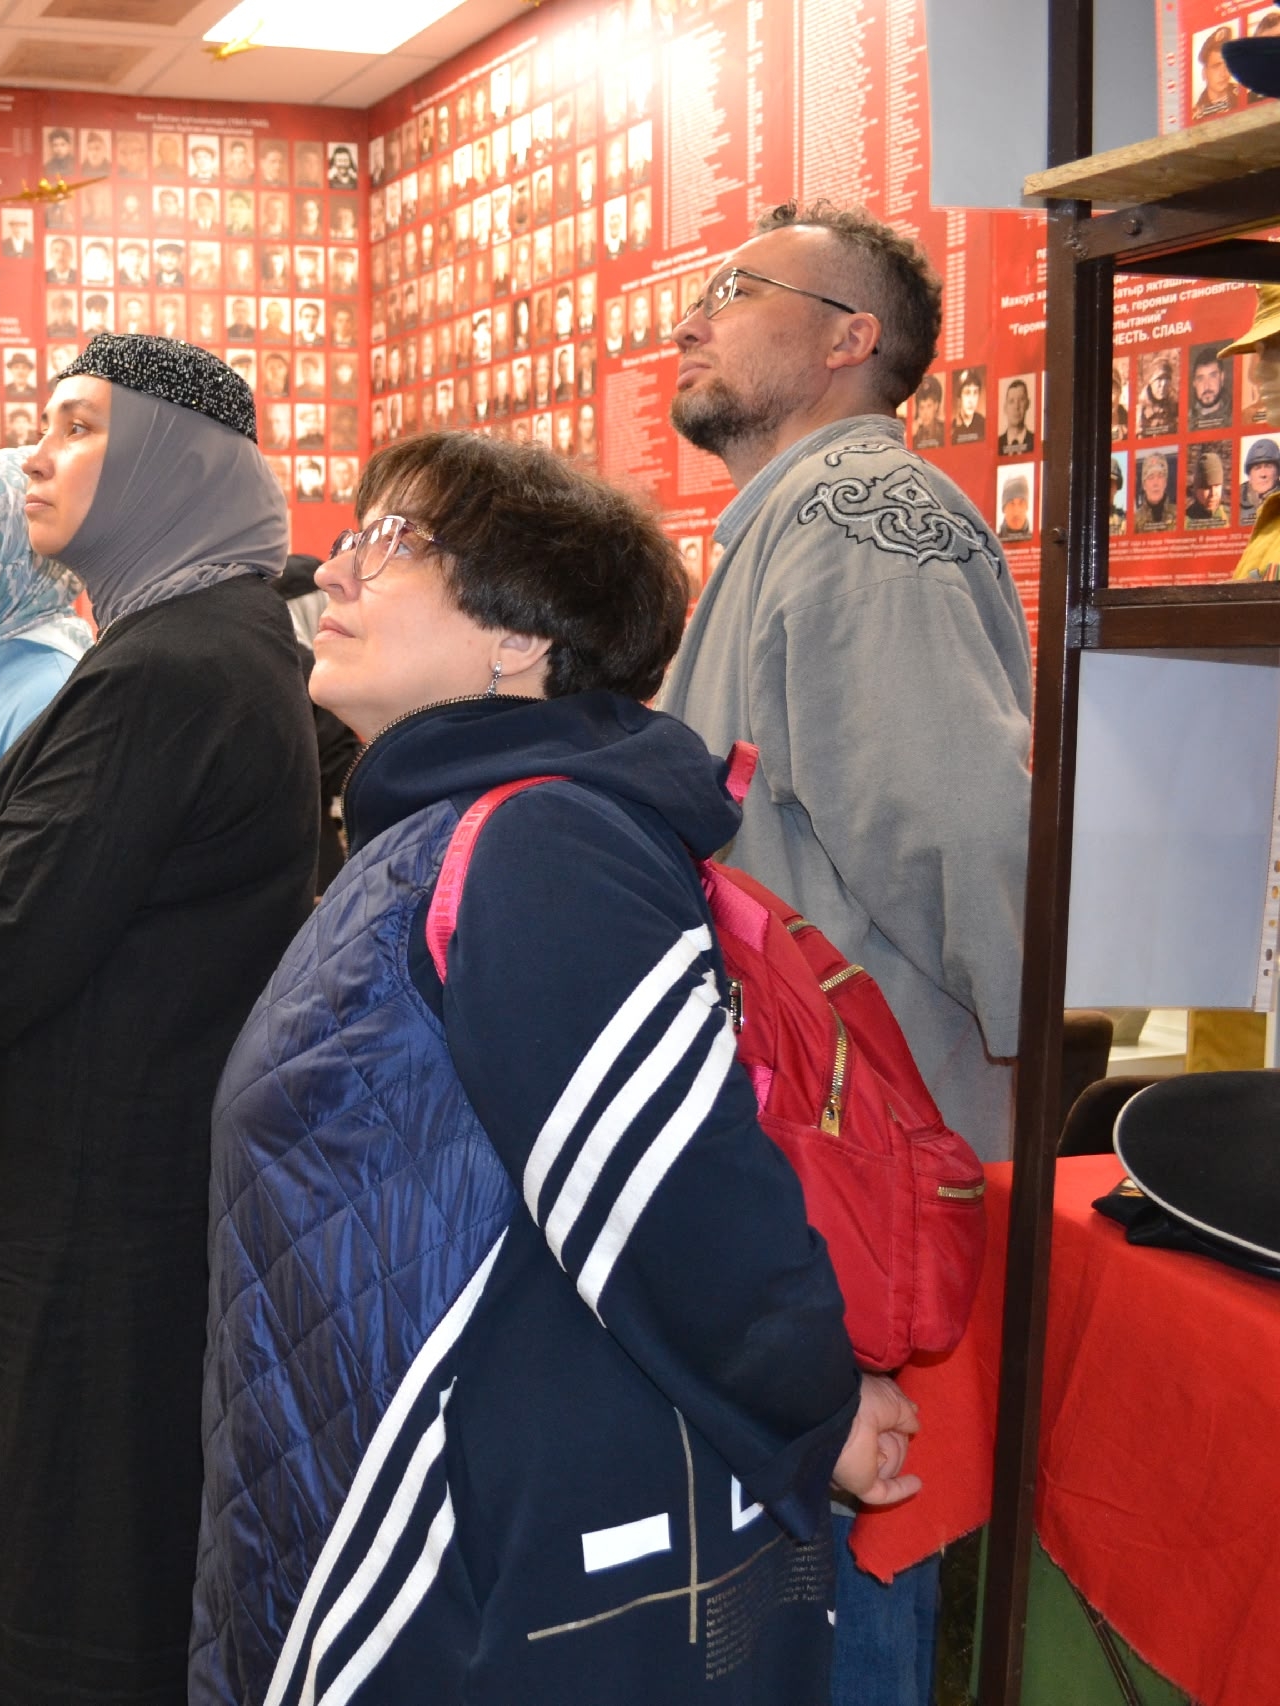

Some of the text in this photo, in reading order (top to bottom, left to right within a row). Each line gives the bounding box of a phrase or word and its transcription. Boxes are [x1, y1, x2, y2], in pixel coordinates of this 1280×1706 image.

[1131, 293, 1177, 311] героями
[1113, 309, 1168, 330] пытаний"
[1152, 320, 1193, 339] СЛАВА
